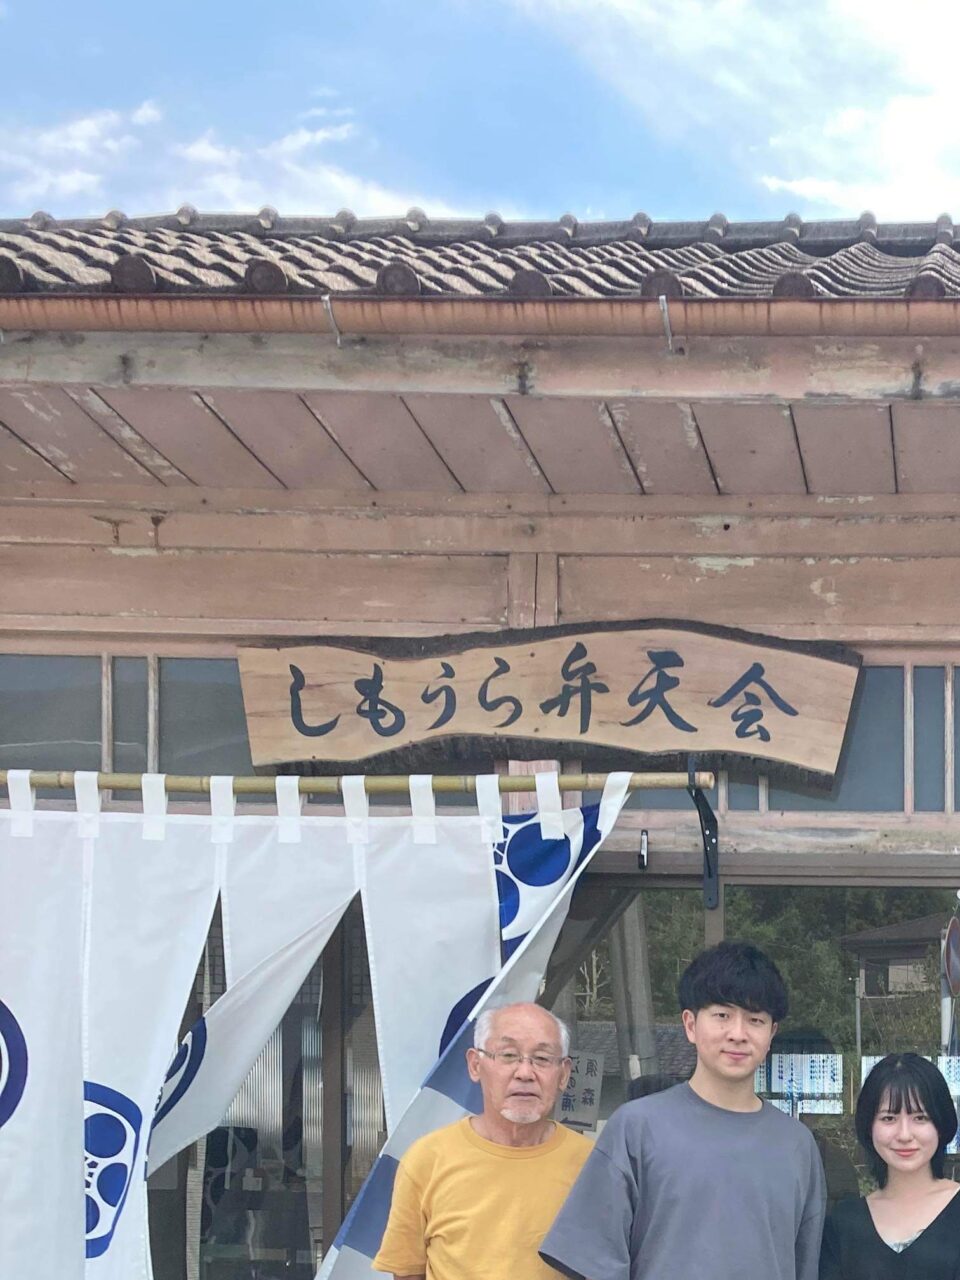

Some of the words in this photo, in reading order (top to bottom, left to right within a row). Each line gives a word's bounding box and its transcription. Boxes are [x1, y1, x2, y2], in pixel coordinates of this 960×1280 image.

[289, 642, 799, 742] しもうら弁天会
